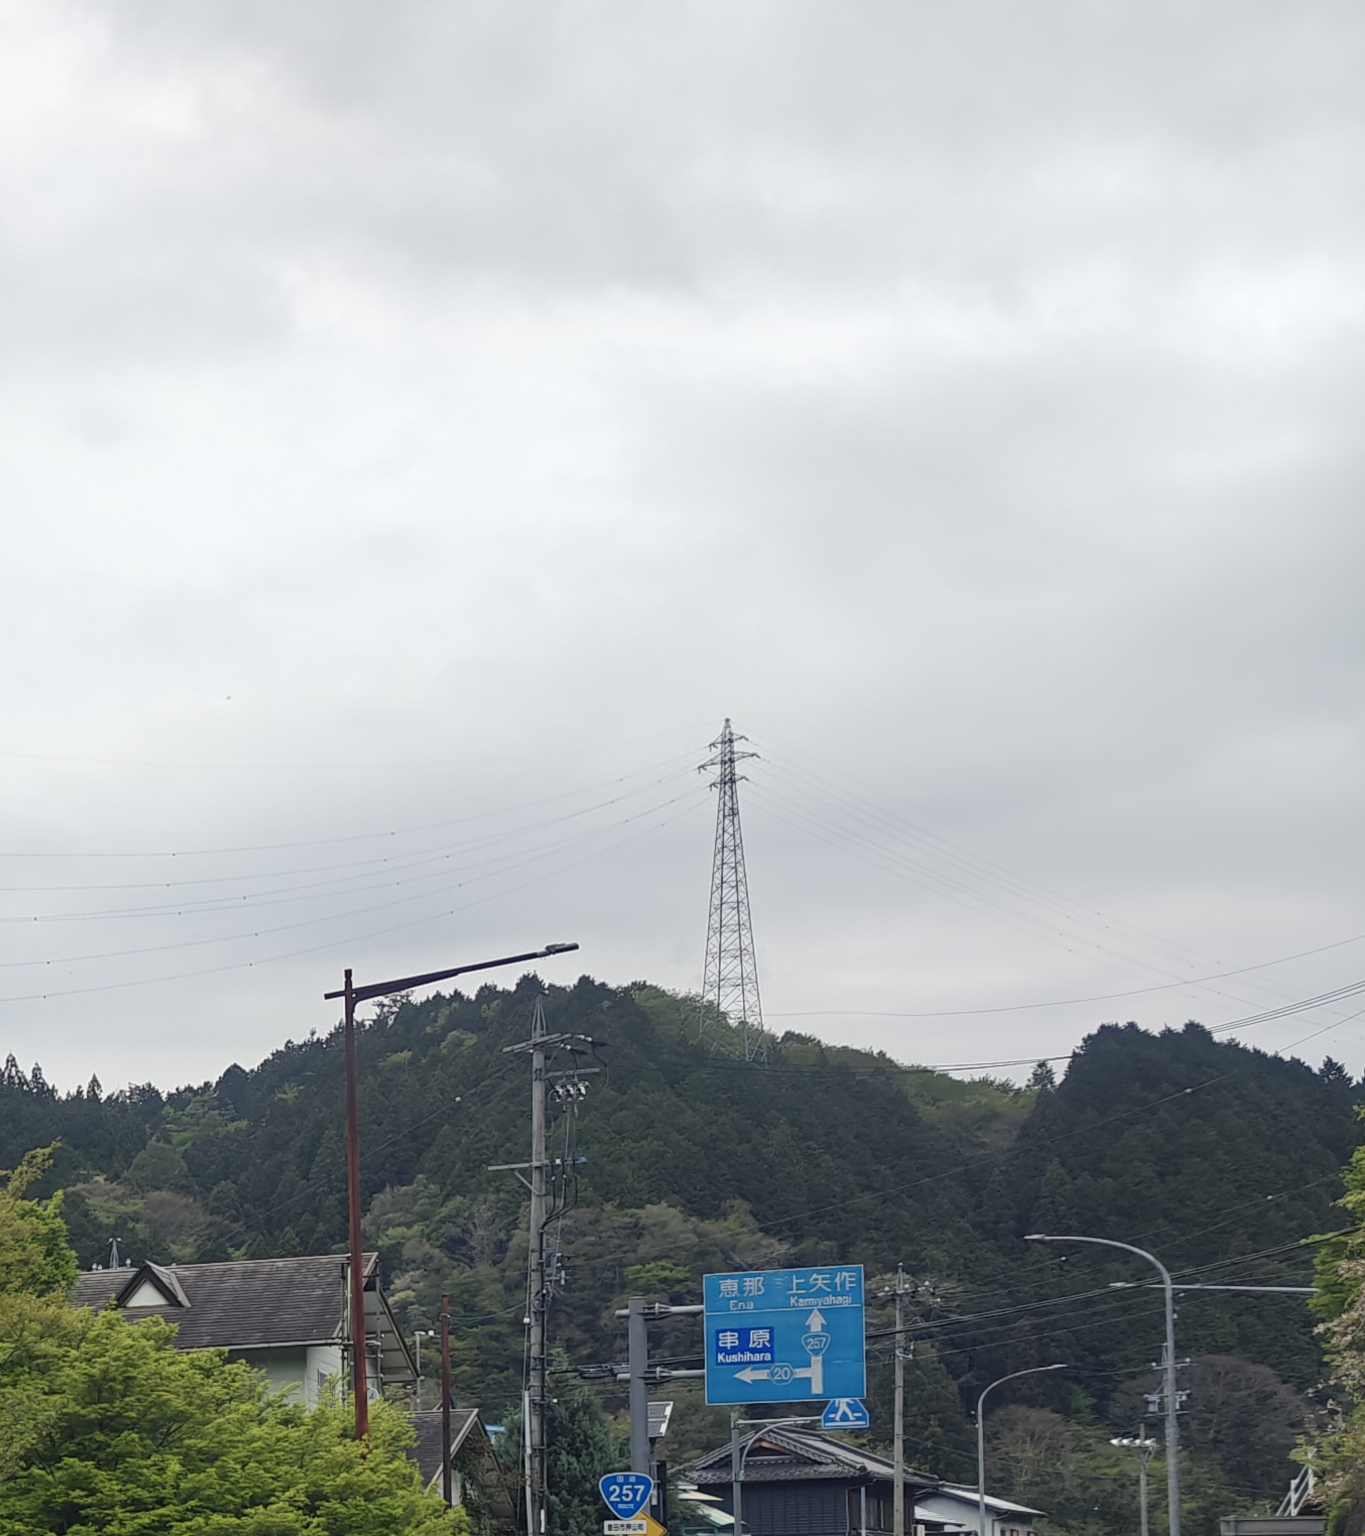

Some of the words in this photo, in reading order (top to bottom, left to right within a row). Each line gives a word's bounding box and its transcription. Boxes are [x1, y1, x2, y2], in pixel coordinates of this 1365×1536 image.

[718, 1276, 765, 1299] 恵那
[785, 1271, 857, 1295] 上矢作
[729, 1299, 754, 1311] Ena
[790, 1294, 852, 1308] Kamiyahagi
[718, 1328, 771, 1350] 串原
[806, 1337, 826, 1350] 257
[717, 1351, 772, 1364] Kushihara
[773, 1366, 790, 1380] 20
[609, 1484, 645, 1502] 257
